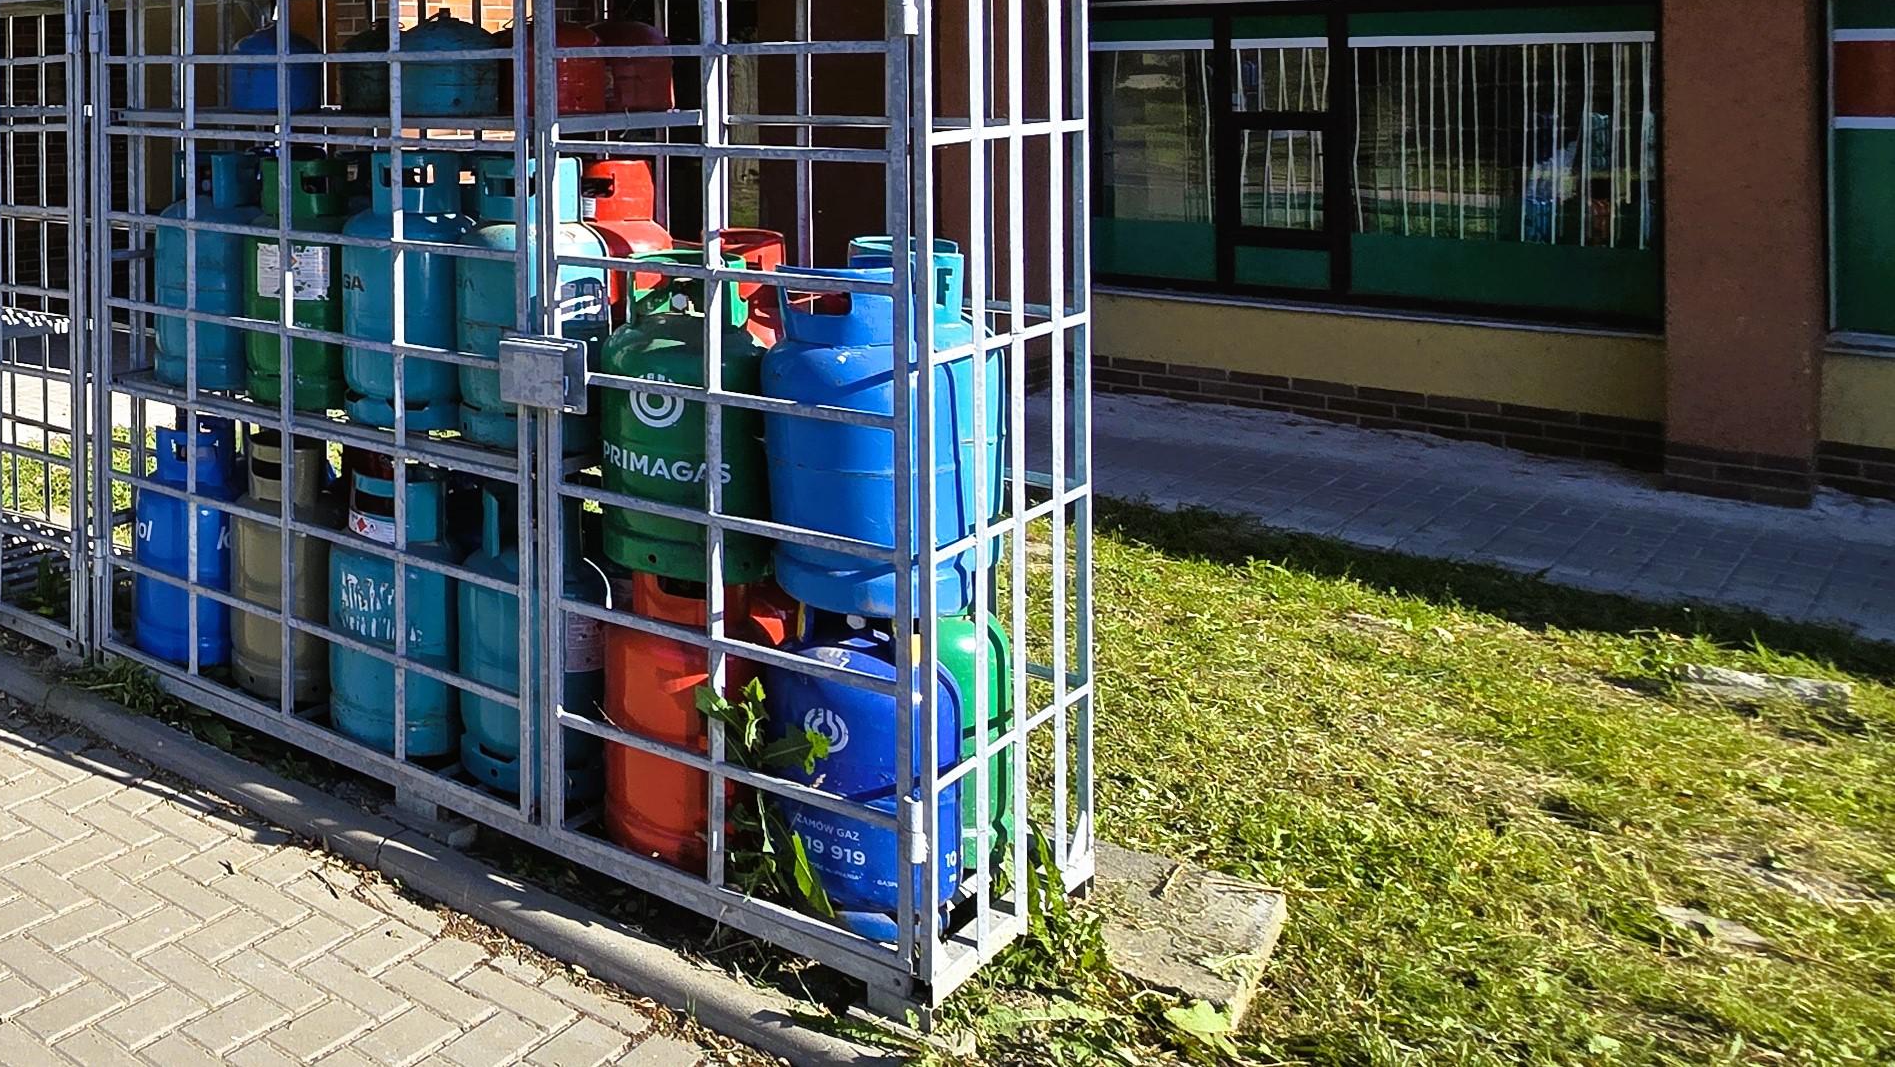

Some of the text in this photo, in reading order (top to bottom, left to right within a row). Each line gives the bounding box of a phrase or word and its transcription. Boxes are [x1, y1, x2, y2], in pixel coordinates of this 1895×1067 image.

[603, 439, 732, 484] PRIMAGAS
[796, 813, 860, 842] ZAMÓW GAZ
[830, 845, 866, 866] 919
